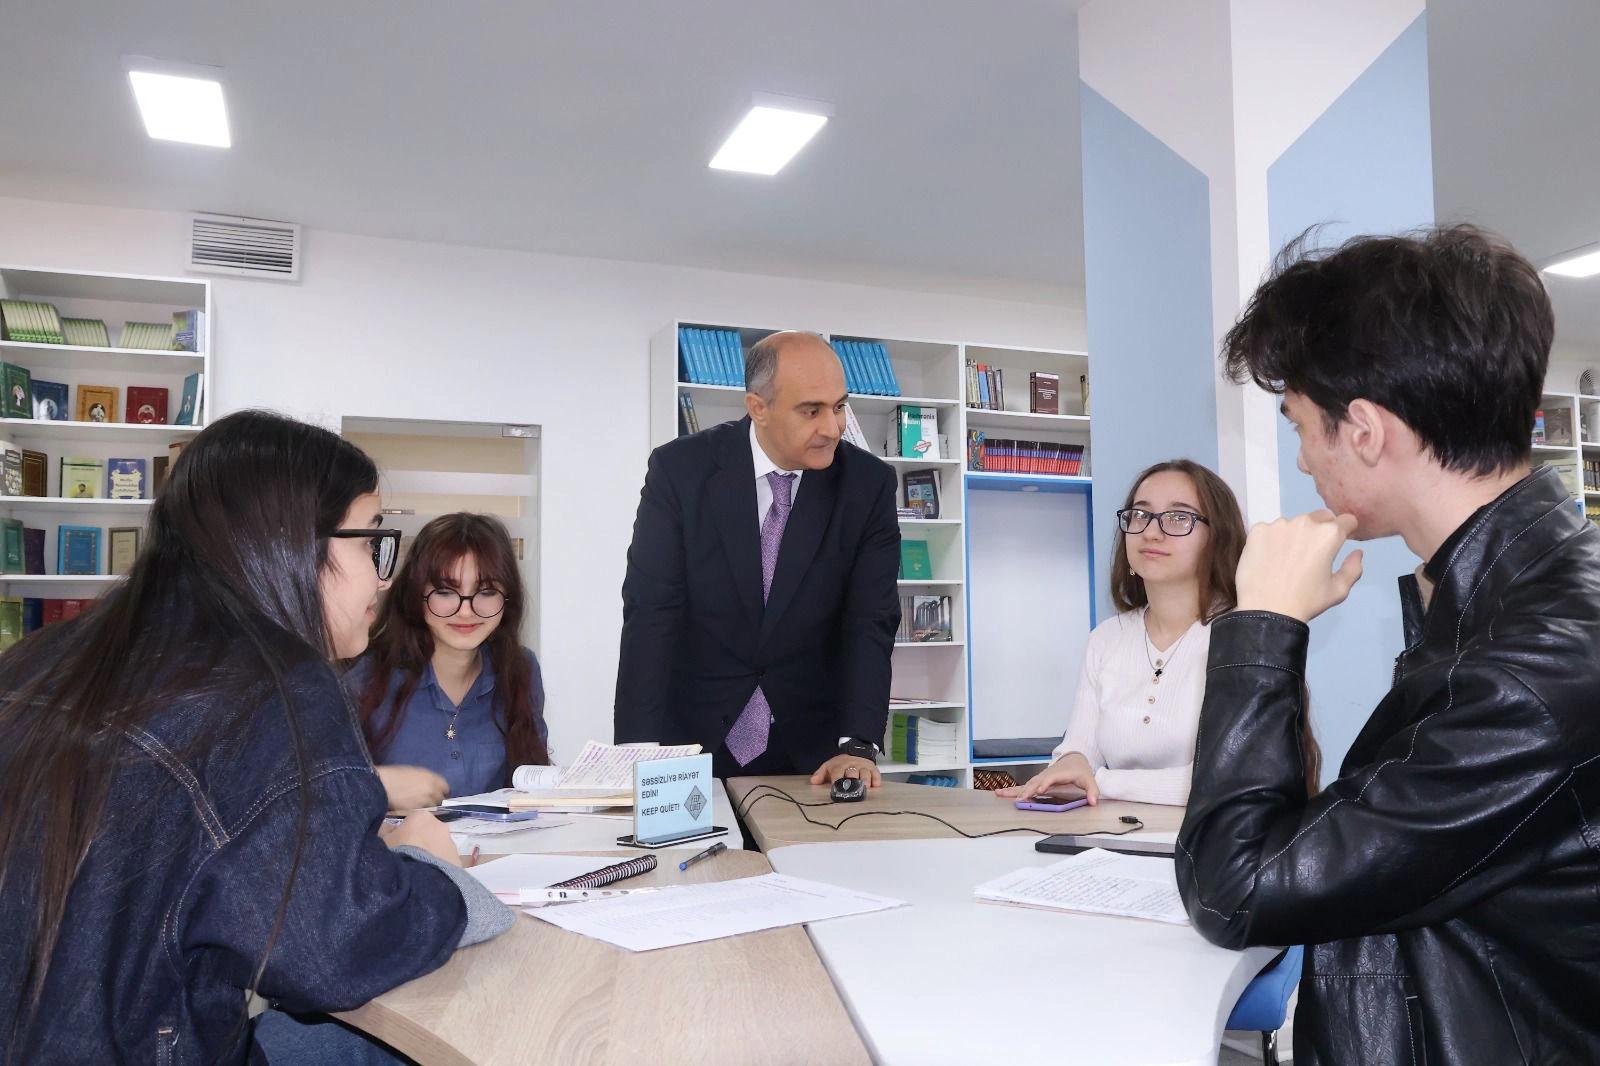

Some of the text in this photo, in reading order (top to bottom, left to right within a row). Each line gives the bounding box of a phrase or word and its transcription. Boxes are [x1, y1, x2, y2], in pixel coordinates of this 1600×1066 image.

[642, 771, 699, 787] SƏSSİZLİYƏ RİAYƏT
[642, 789, 659, 799] EDİN!
[642, 806, 659, 817] KEEP
